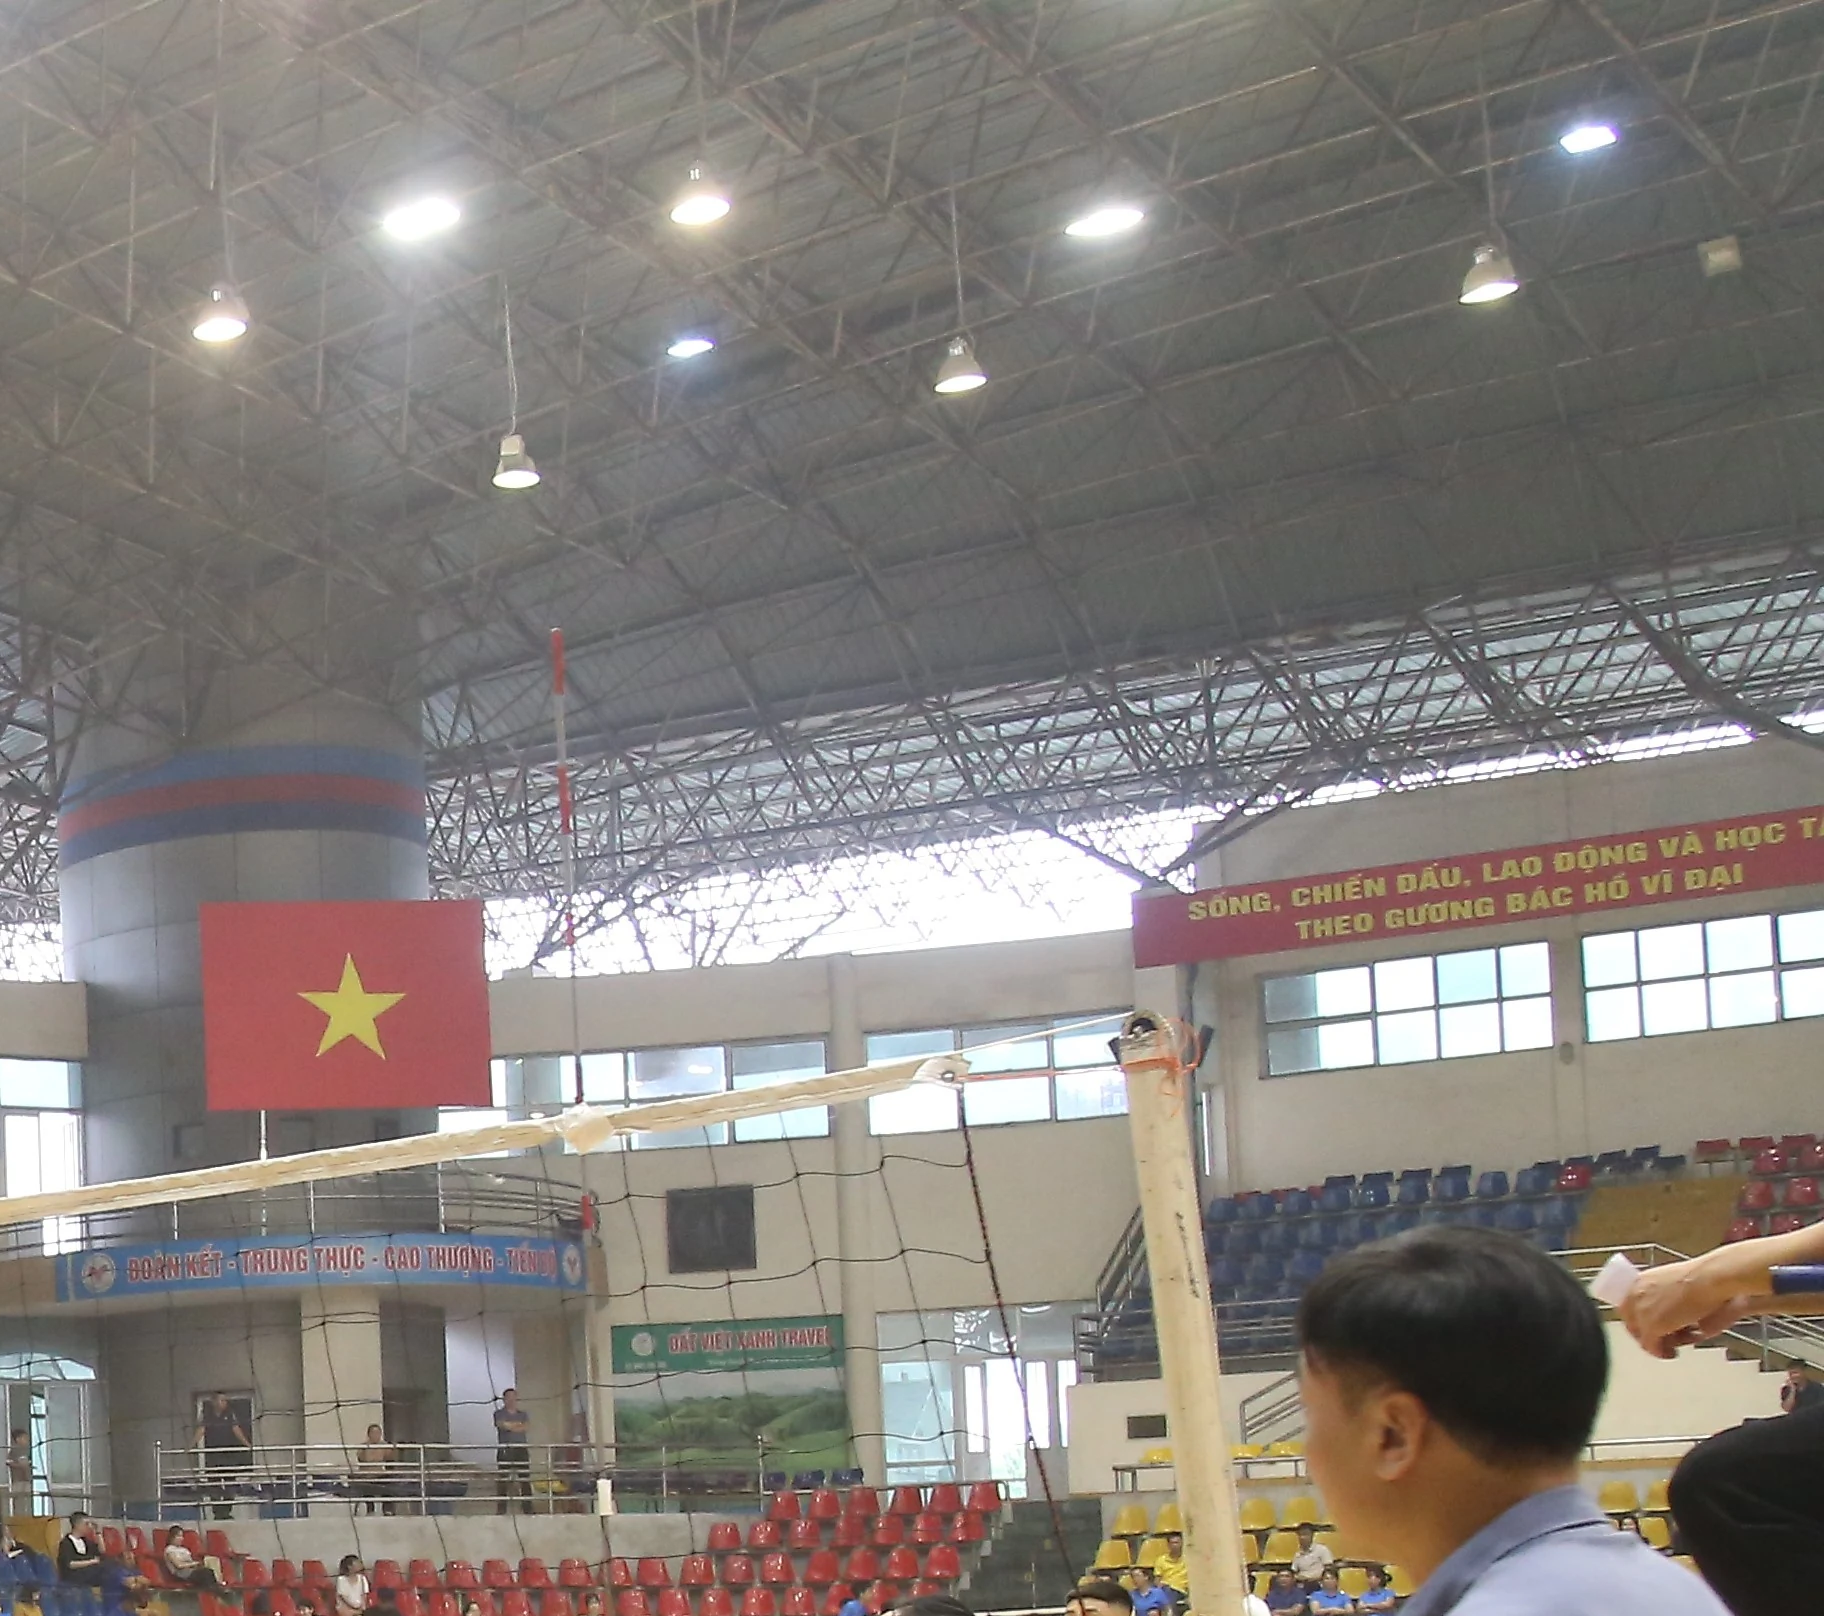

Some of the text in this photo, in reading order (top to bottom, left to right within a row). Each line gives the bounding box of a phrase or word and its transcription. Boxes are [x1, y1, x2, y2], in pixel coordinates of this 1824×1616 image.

[1188, 890, 1281, 922] SỐNG,
[1291, 872, 1387, 908] CHIẾN
[1482, 855, 1543, 883] LAO
[1553, 842, 1648, 874] ĐỘNG
[1658, 830, 1704, 860] VÀ
[1715, 821, 1787, 851] HỌC
[1295, 862, 1744, 941] THEO GƯƠNG BÁC HỒ VĨ ĐẠI
[127, 1250, 181, 1284] ĐOÀN
[185, 1243, 224, 1279] KẾT
[238, 1246, 310, 1276] TRUNG
[313, 1242, 366, 1278] THỰC
[383, 1243, 422, 1273] CAO
[425, 1243, 496, 1278] THƯỢNG
